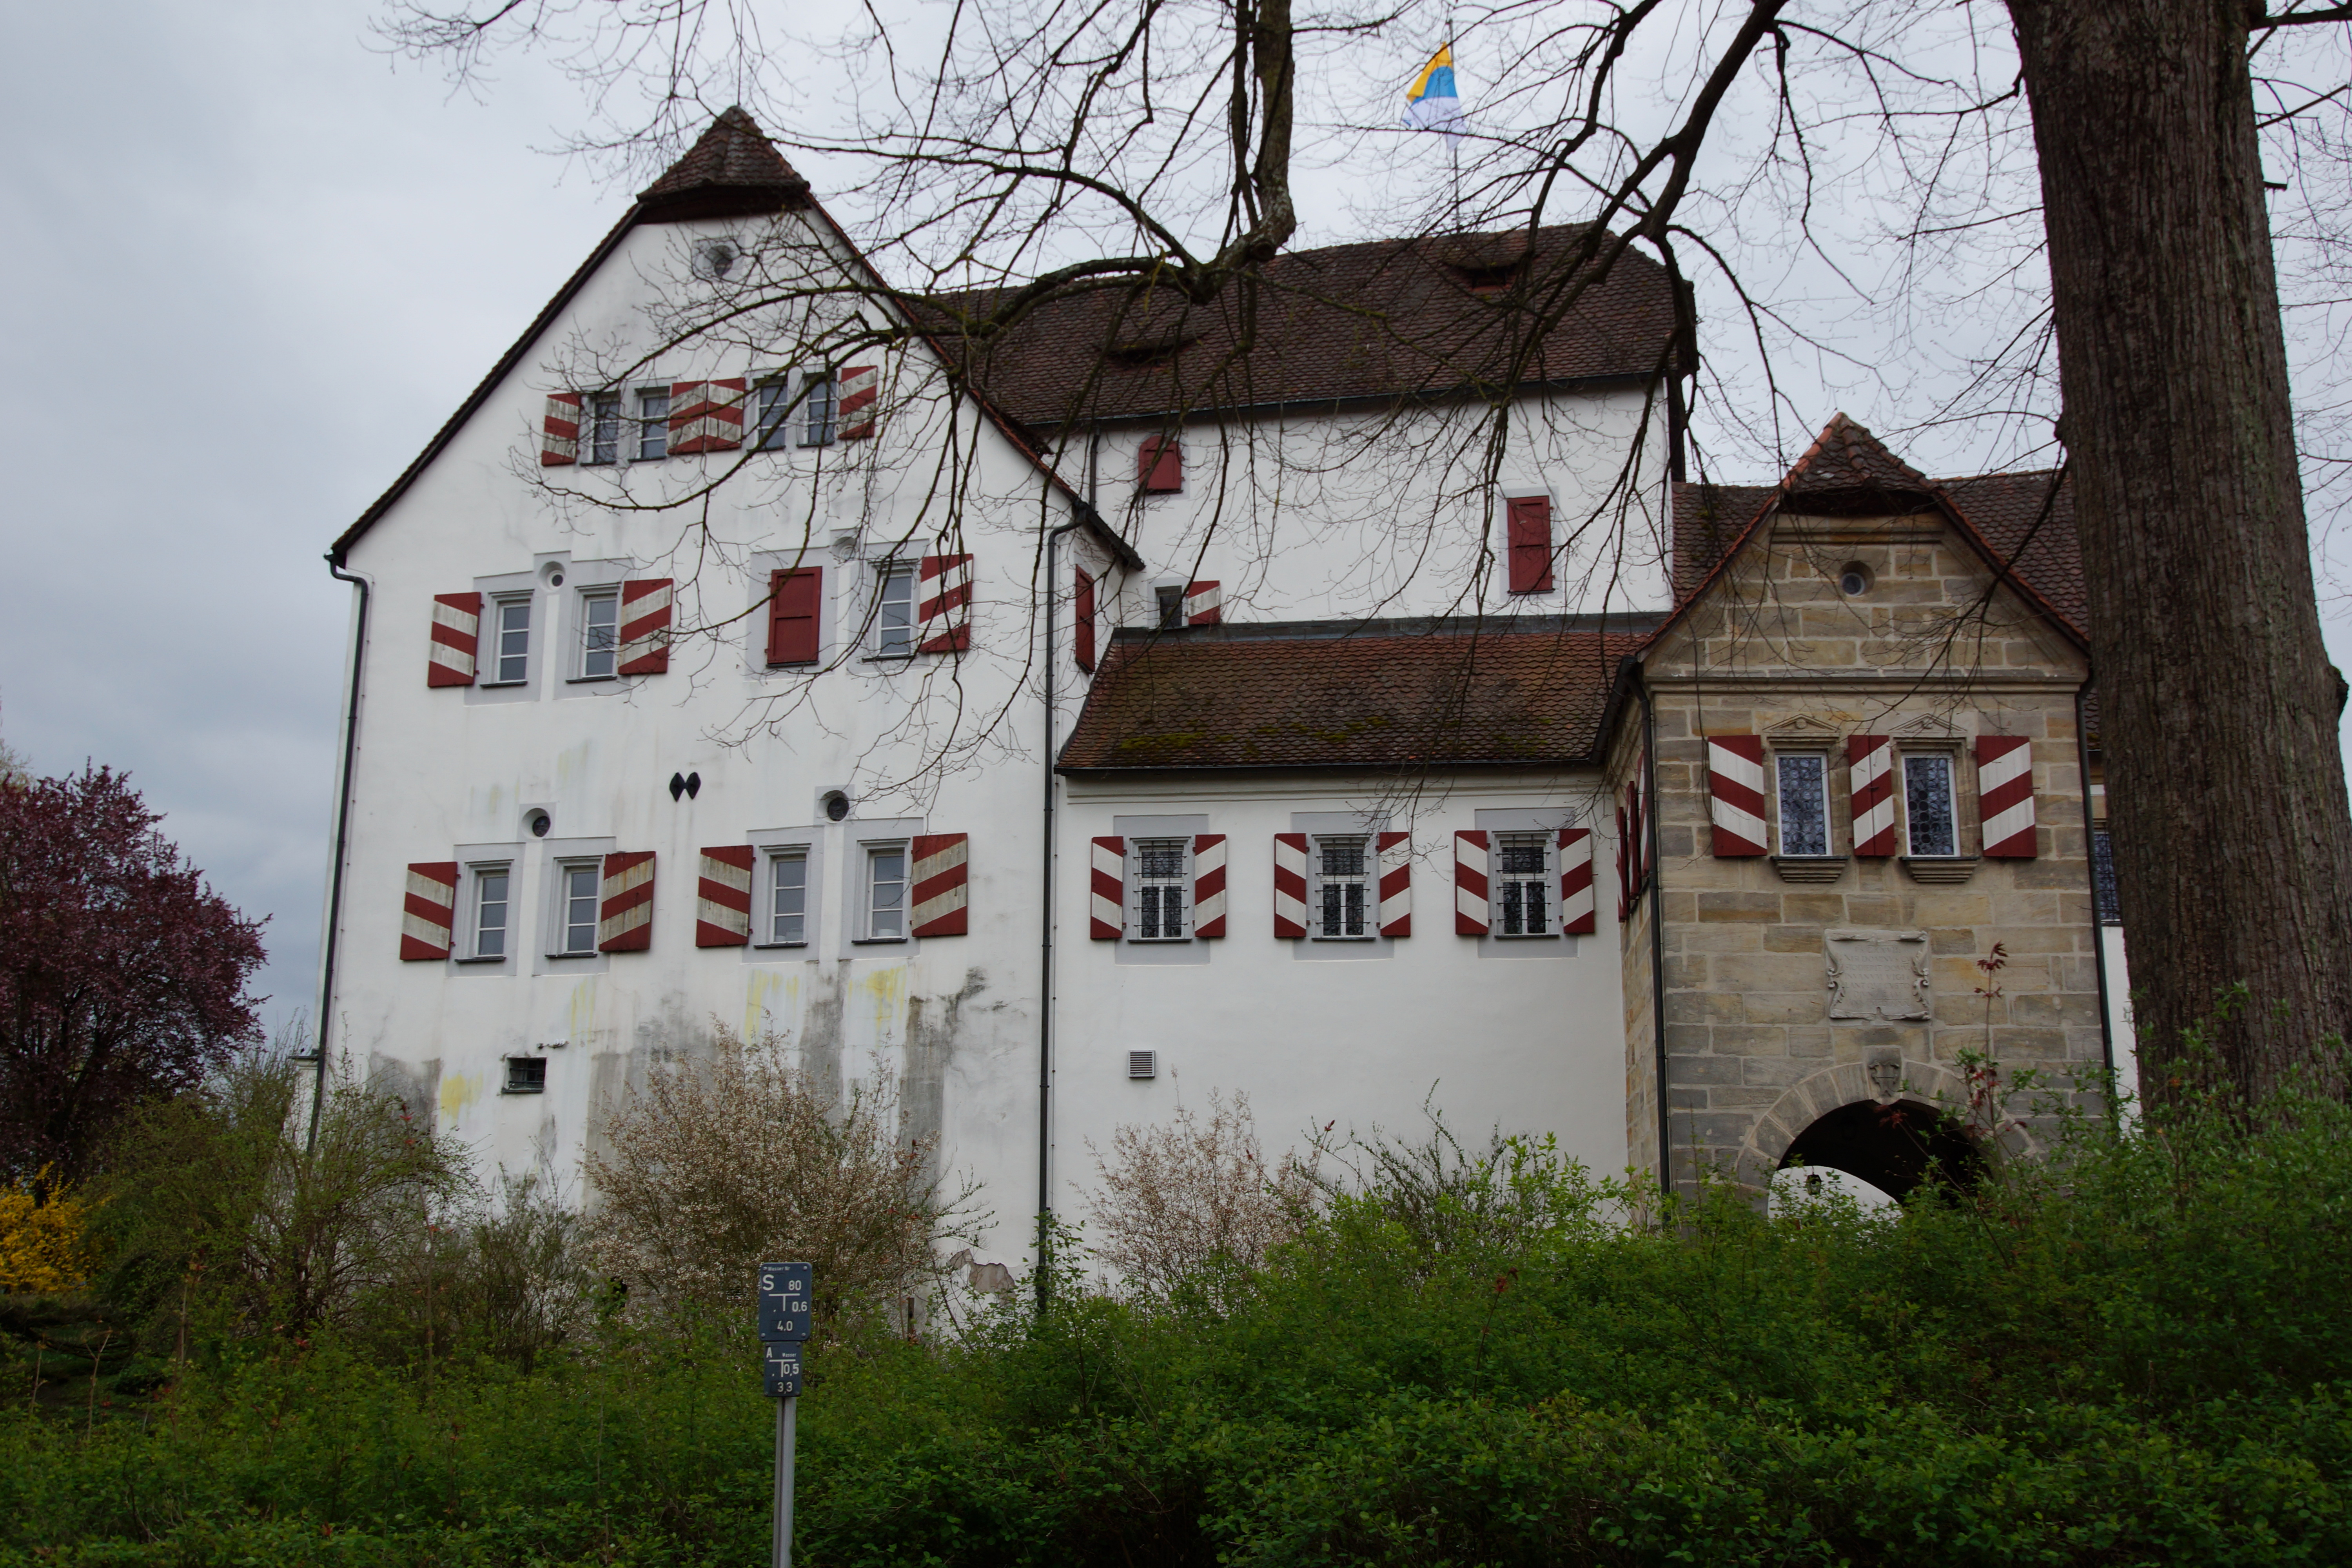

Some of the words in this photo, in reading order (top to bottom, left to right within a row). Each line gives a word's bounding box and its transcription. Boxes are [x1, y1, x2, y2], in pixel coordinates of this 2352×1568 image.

[762, 1274, 774, 1291] S
[789, 1280, 801, 1291] 80
[792, 1301, 808, 1312] 0,6
[777, 1320, 793, 1331] 4,0
[766, 1347, 773, 1358] A
[784, 1363, 799, 1376] 0,5
[777, 1381, 793, 1394] 3,3
